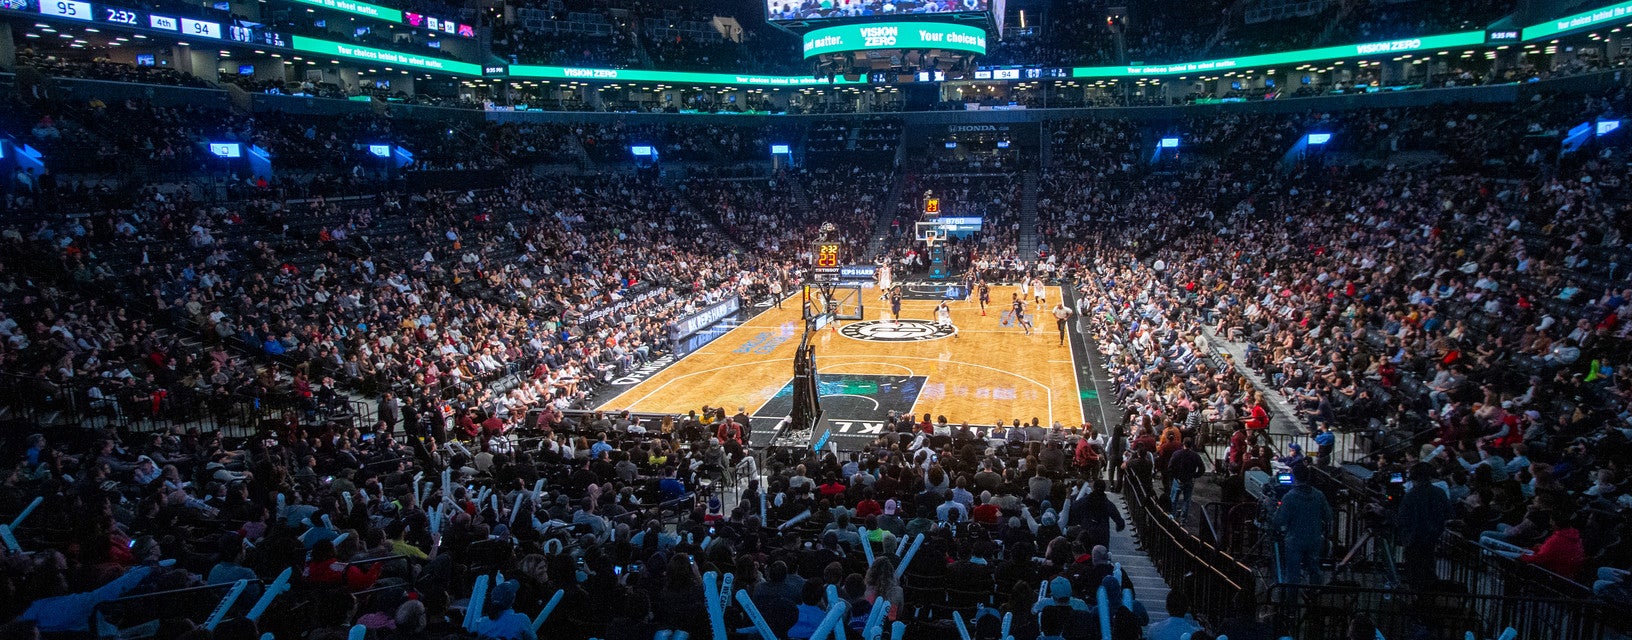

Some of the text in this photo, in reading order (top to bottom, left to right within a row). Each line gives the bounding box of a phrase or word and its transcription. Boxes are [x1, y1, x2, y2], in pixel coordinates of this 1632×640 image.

[57, 1, 76, 15] 95
[107, 8, 137, 24] 2:32
[156, 18, 171, 28] 4th
[194, 22, 210, 35] 94
[859, 27, 898, 37] VISION
[919, 30, 944, 42] Your
[946, 32, 977, 45] choices
[815, 36, 843, 48] matter.
[864, 36, 897, 47] ZERO
[1356, 38, 1421, 55] VISION ZERO
[337, 45, 353, 55] Your
[353, 48, 377, 59] choices
[563, 67, 618, 78] VISION ZERO
[820, 245, 838, 254] 2:32
[818, 253, 837, 266] 23
